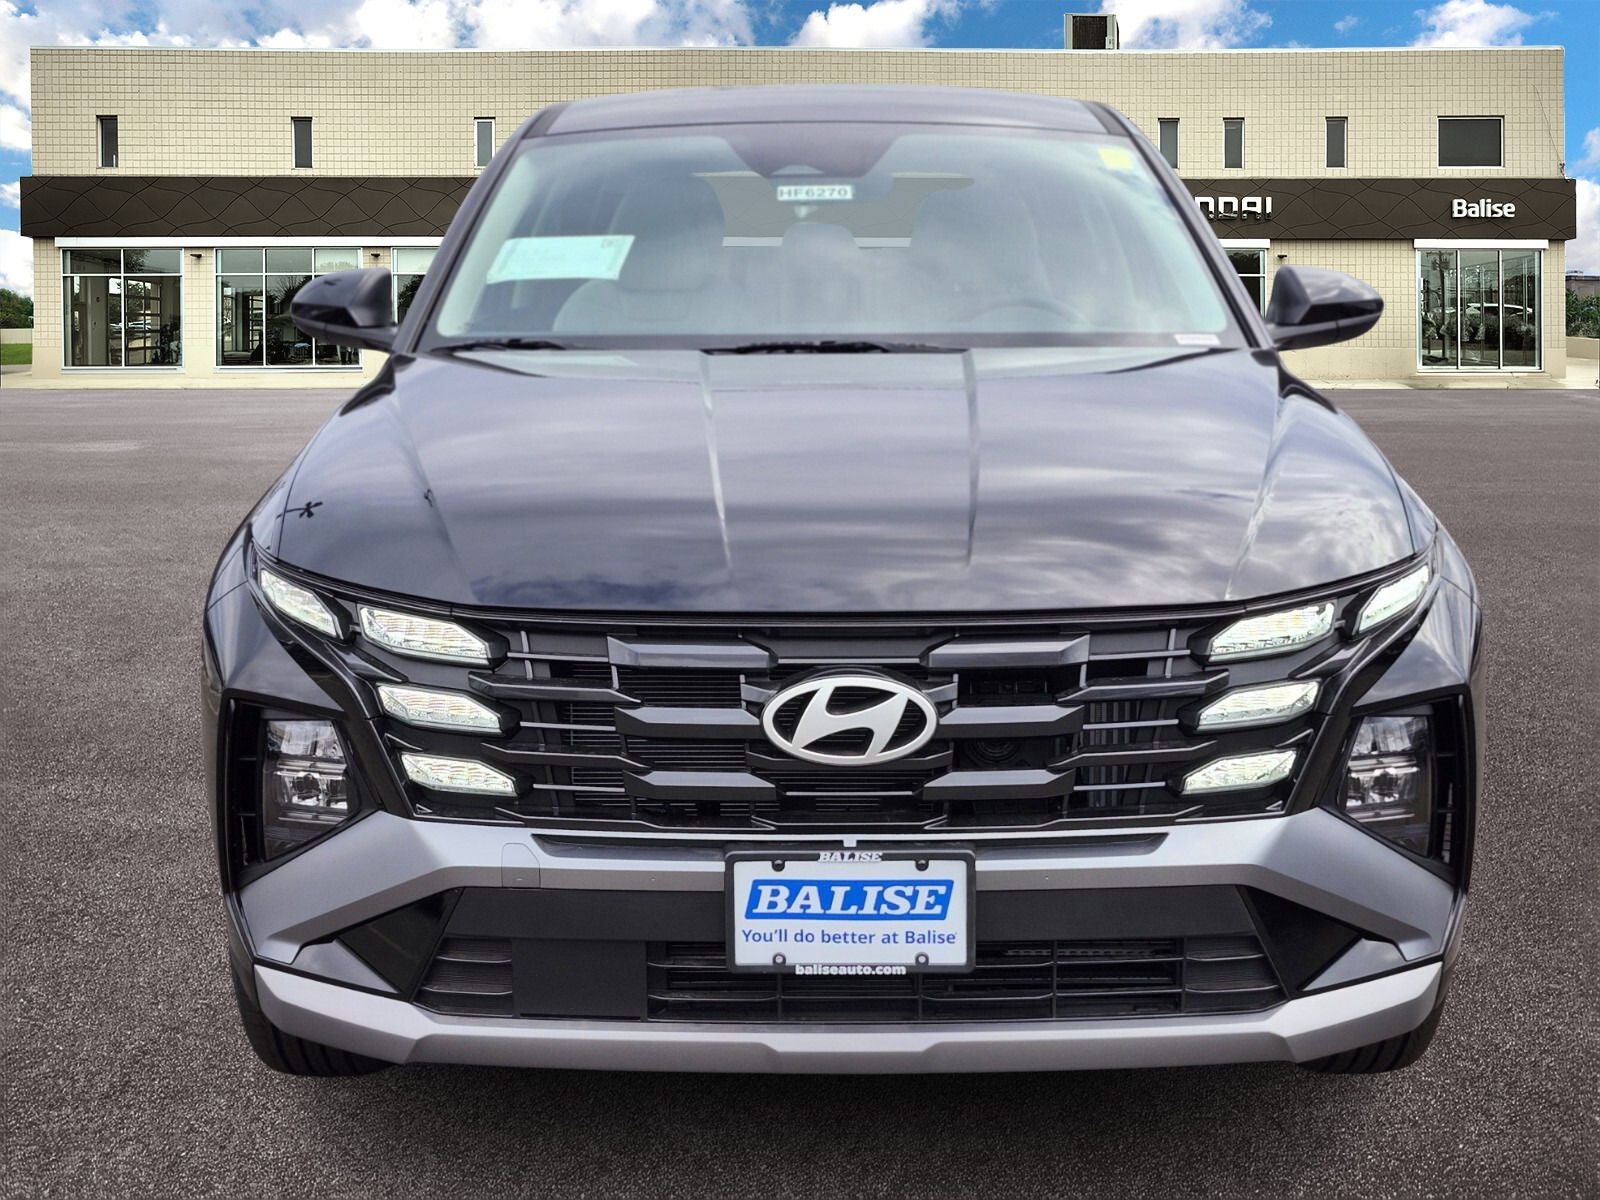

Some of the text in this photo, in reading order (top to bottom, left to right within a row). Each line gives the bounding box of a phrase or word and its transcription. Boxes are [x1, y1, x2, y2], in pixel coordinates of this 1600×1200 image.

[779, 188, 848, 198] HF6270
[1451, 198, 1516, 218] Balise
[817, 852, 883, 862] BALISE
[752, 884, 947, 915] BALISE
[794, 929, 816, 943] do
[821, 930, 876, 944] better
[881, 931, 898, 944] at
[905, 930, 957, 944] Balise
[795, 964, 907, 975] baliseauto.com
